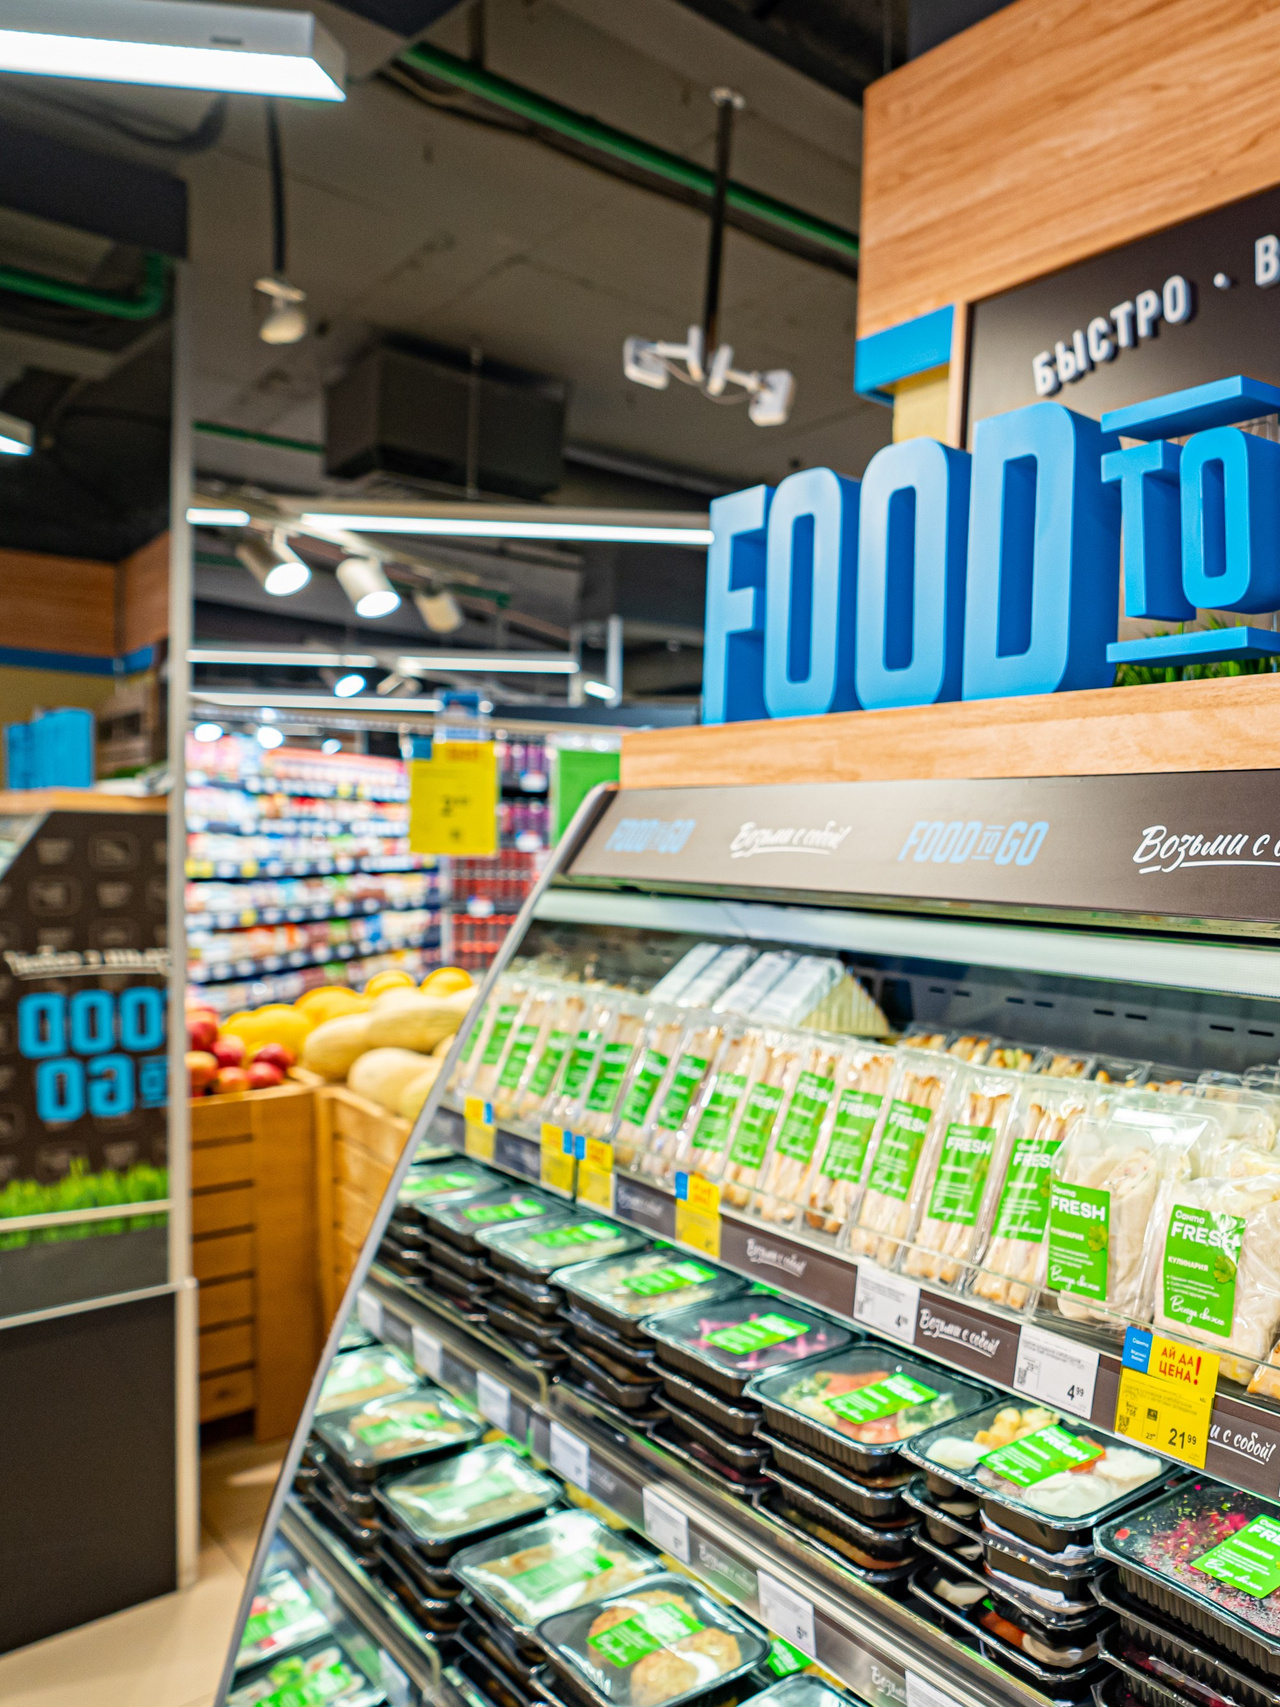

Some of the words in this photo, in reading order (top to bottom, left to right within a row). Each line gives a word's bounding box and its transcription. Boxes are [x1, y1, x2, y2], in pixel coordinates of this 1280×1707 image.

[1031, 275, 1197, 397] БЫСТРО
[701, 400, 1119, 726] FOOD
[899, 820, 982, 864] FOOD
[998, 821, 1050, 866] GO
[1132, 825, 1246, 872] Возьми
[1252, 831, 1265, 857] с
[888, 1112, 927, 1133] FRESH
[945, 1135, 993, 1155] FRESH
[1050, 1195, 1106, 1222] FRESH
[1175, 1209, 1205, 1225] Санта
[1170, 1220, 1241, 1250] FRESH
[1167, 1255, 1209, 1272] КУЛИНАРИЯ
[1160, 1347, 1176, 1360] АЙ
[1178, 1353, 1194, 1367] ДА
[1222, 1429, 1232, 1443] с
[1233, 1431, 1277, 1462] собой!
